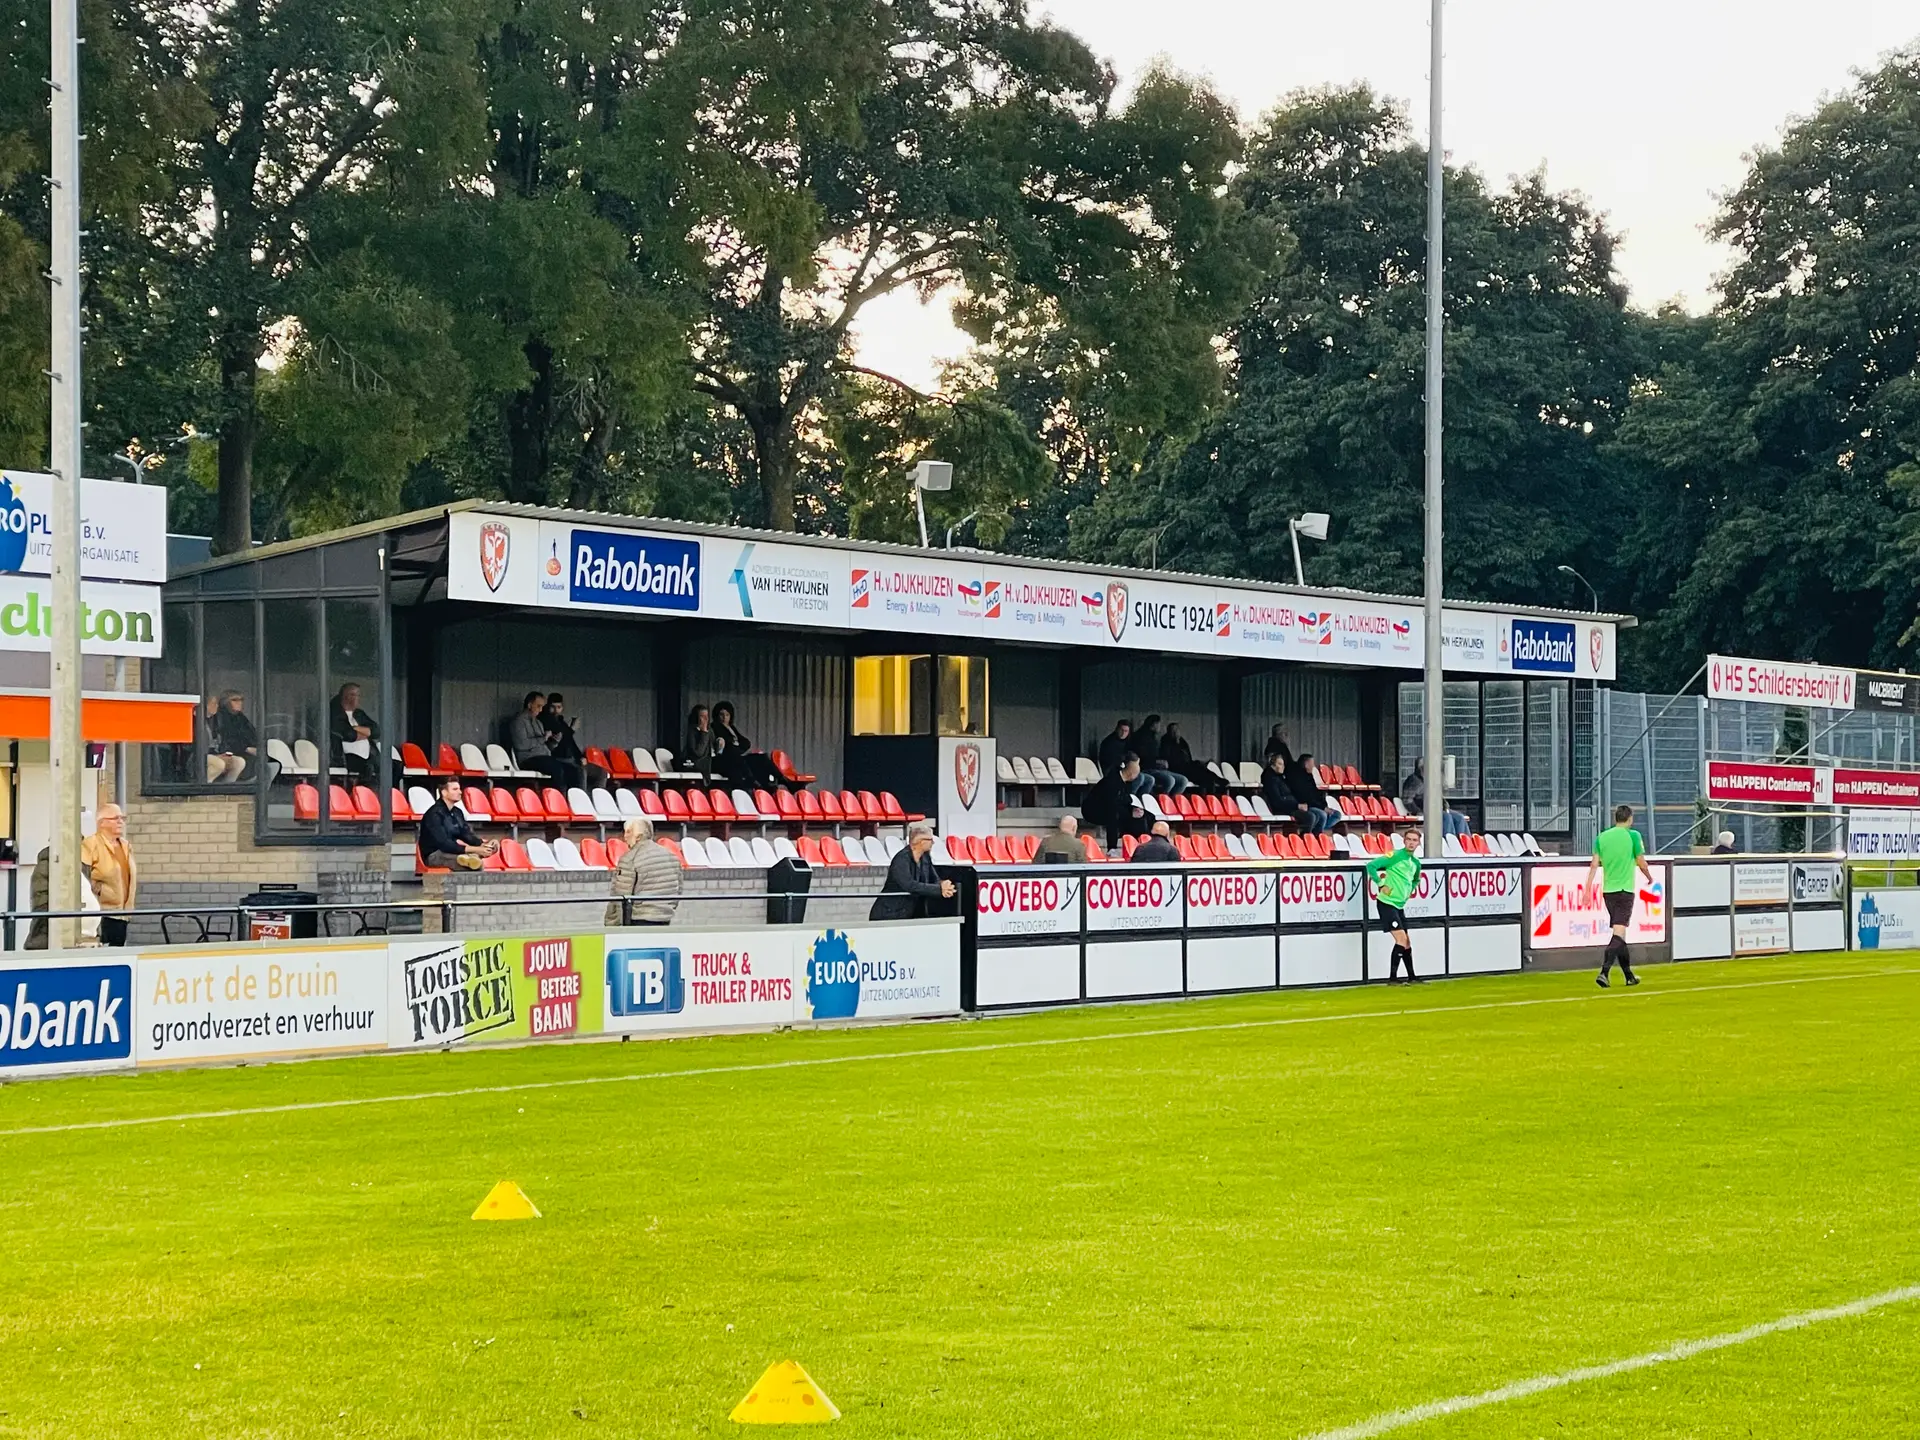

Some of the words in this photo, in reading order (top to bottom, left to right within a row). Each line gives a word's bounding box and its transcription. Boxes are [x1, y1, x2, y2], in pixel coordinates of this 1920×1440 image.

[84, 526, 106, 540] B.V.
[575, 544, 696, 597] Rabobank
[752, 576, 770, 591] VAN
[774, 578, 829, 596] HERWIJNEN
[894, 572, 954, 598] DIJKHUIZEN
[1023, 584, 1077, 608] DIJKHUIZEN
[886, 599, 908, 614] Energy
[910, 602, 915, 613] &
[916, 602, 941, 616] Mobility
[1016, 609, 1036, 624] Energy
[1038, 612, 1042, 622] &
[1043, 612, 1066, 627] Mobility
[1135, 601, 1176, 630] SINCE
[1182, 605, 1214, 633] 1924
[1243, 628, 1260, 643] Energy
[1266, 630, 1285, 644] Mobility
[1513, 629, 1574, 663] Rabobank
[1725, 664, 1743, 692] HS
[1748, 667, 1840, 706] Schildersbedrijf
[1711, 776, 1729, 788] van
[1729, 775, 1767, 790] HAPPEN
[1834, 783, 1850, 793] van
[1851, 781, 1882, 795] HAPPEN
[1849, 833, 1879, 853] METTLER
[1883, 833, 1908, 853] TOLEDO
[977, 880, 1059, 914] COVEBO
[1087, 877, 1163, 909] COVEBO
[1188, 876, 1258, 907] COVEBO
[1280, 874, 1346, 905] COVEBO
[1449, 870, 1507, 898] COVEBO
[1807, 878, 1829, 893] GROEP
[1001, 920, 1057, 933] UITZENDGROEP
[1110, 915, 1162, 928] UITZENDGROEP
[409, 941, 507, 1000] LOGISTIC
[529, 942, 568, 973] JOUW
[692, 953, 737, 977] TRUCK
[741, 952, 751, 975] &
[152, 969, 214, 1005] Aart
[225, 965, 257, 1001] de
[269, 962, 338, 999] Bruin
[627, 959, 664, 1005] TB
[900, 967, 916, 980] B.V.
[541, 975, 580, 999] BETERE
[692, 980, 746, 1005] TRAILER
[750, 978, 791, 1003] PARTS
[861, 985, 940, 1003] UITZENDORGANISATIE
[411, 976, 511, 1043] FORCE
[533, 1002, 573, 1034] BAAN
[152, 1012, 271, 1050] grondverzet
[277, 1014, 298, 1035] en
[303, 1005, 374, 1033] verhuur
